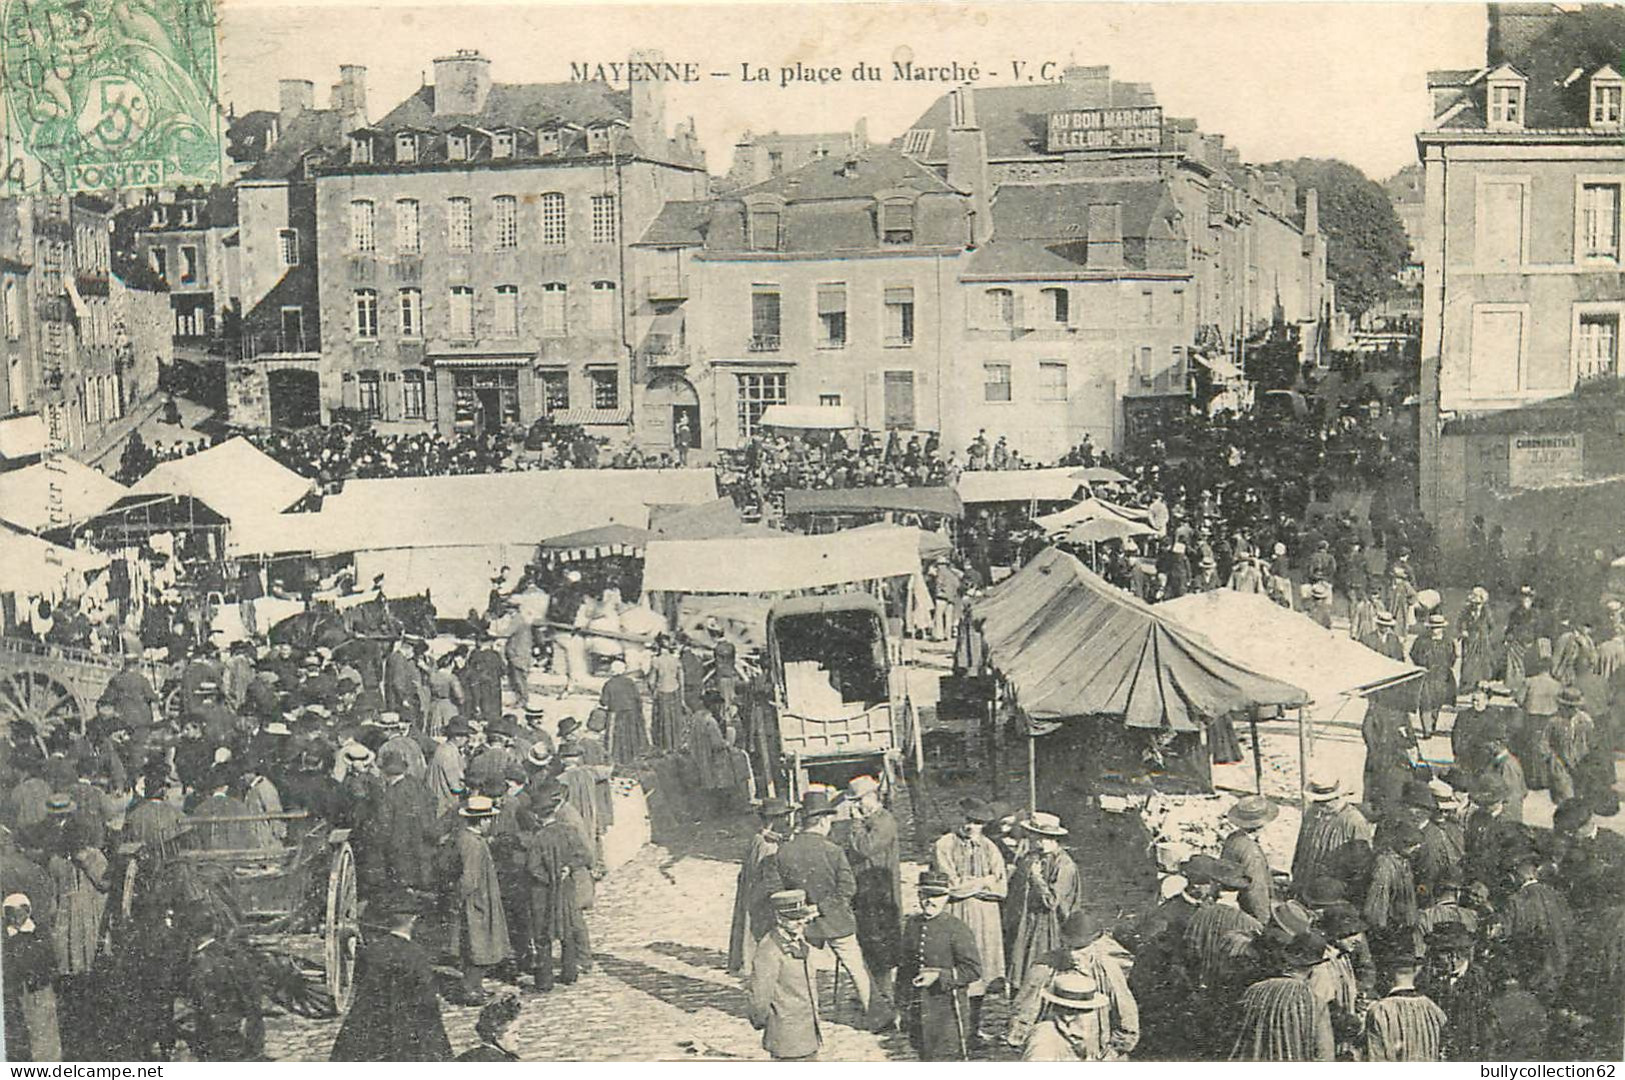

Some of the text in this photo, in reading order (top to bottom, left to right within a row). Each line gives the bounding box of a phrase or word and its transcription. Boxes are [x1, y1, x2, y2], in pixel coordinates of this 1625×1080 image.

[1052, 113, 1069, 129] AU
[1073, 112, 1101, 128] BON
[69, 163, 161, 190] POSTES
